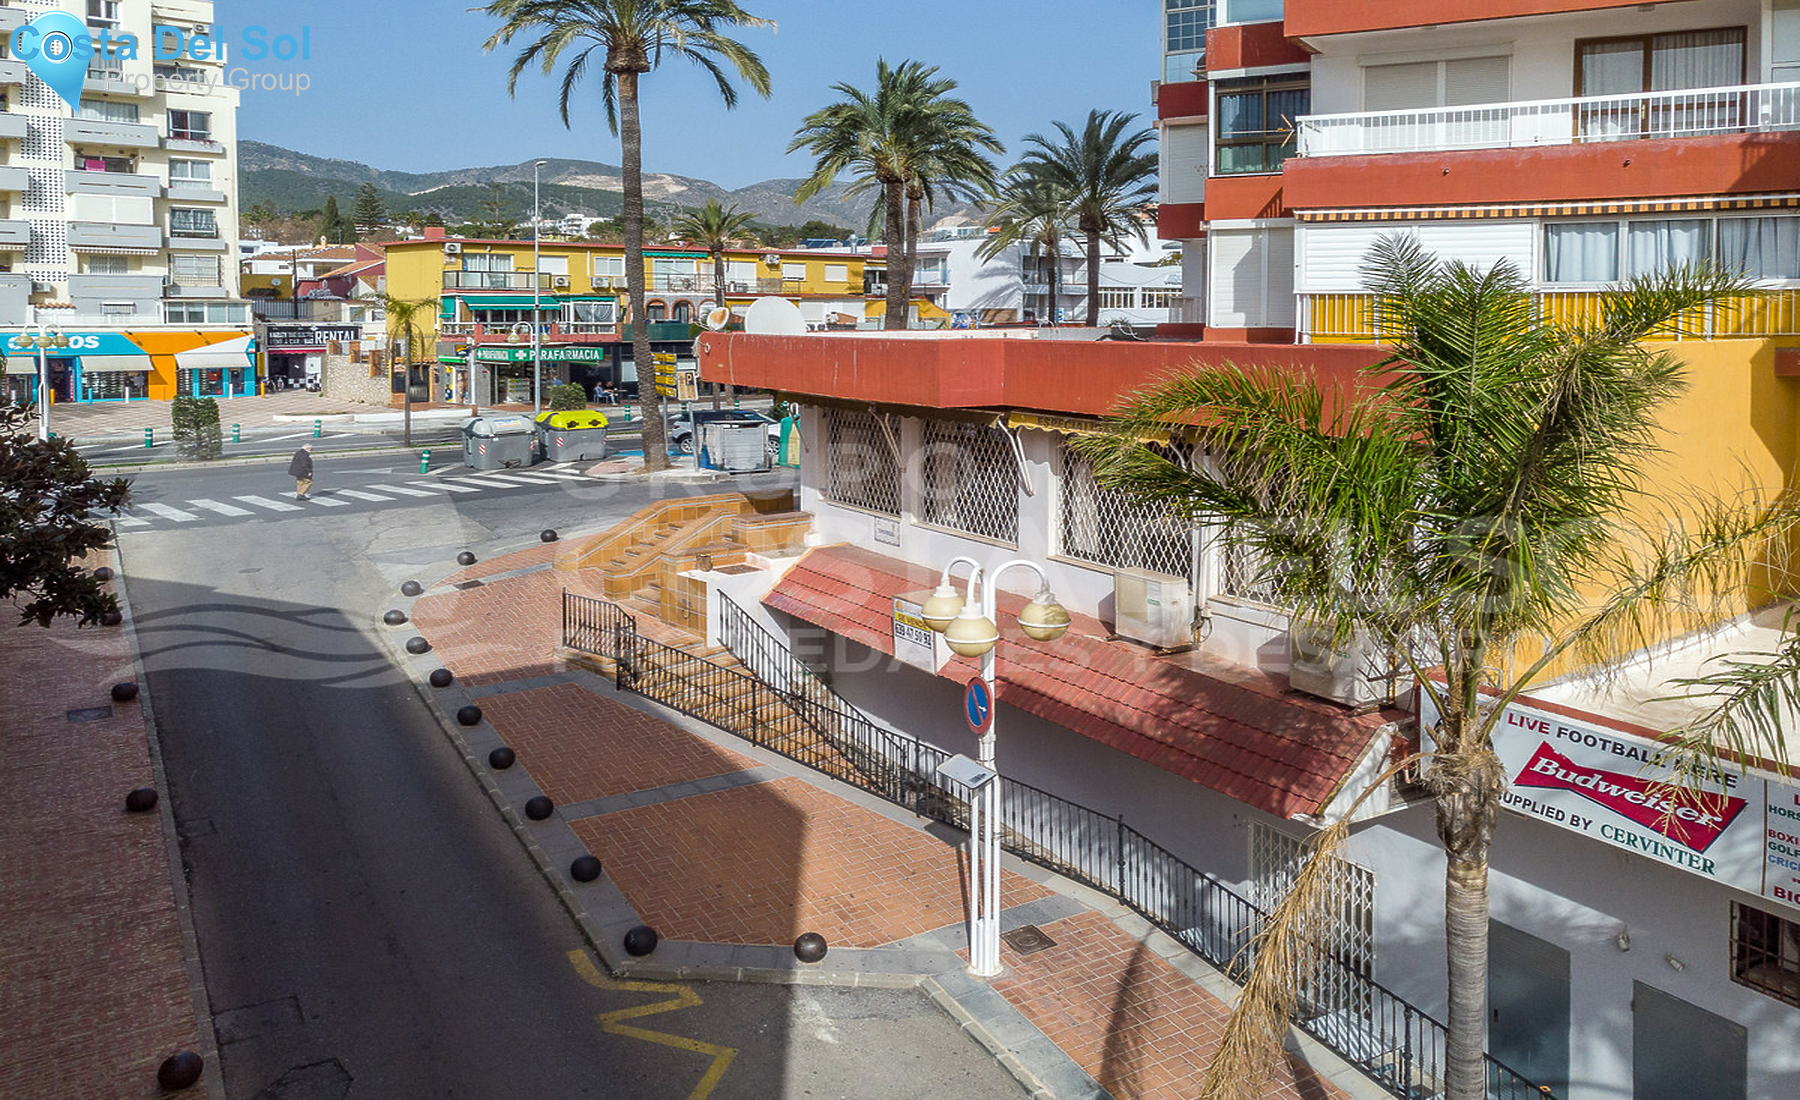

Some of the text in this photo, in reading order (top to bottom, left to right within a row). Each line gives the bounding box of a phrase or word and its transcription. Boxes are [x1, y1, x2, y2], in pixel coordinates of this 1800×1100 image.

[529, 349, 600, 360] PRAFARMACIA
[1507, 712, 1551, 735] LIVE
[1556, 726, 1667, 768] FOOTBALL
[1529, 756, 1723, 826] Budweiser
[1570, 812, 1594, 831] BY
[1600, 823, 1716, 876] CERVINTER
[1768, 854, 1800, 872] CRIC
